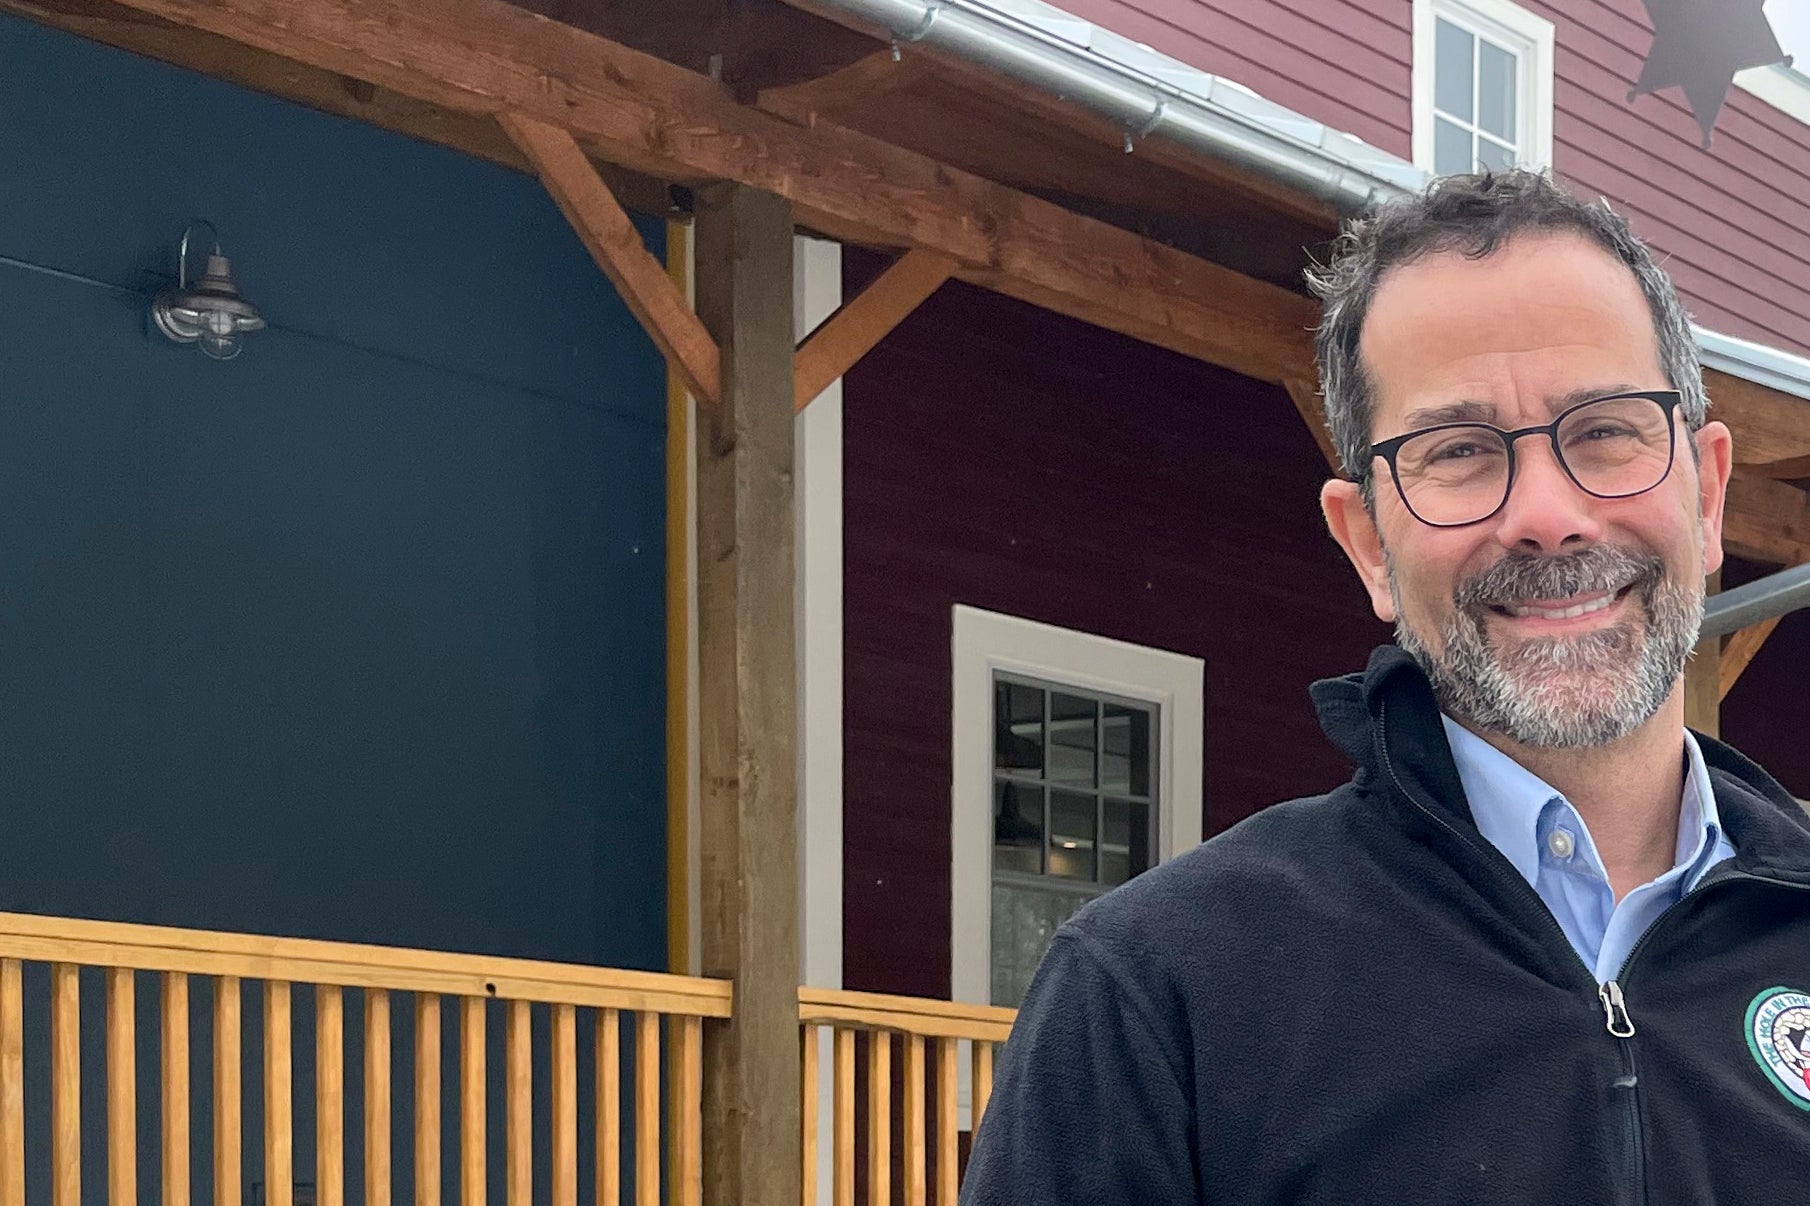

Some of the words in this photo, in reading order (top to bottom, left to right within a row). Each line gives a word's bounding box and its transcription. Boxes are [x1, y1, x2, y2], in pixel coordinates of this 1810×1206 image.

[1771, 998, 1787, 1010] IN
[1784, 996, 1808, 1006] THE
[1760, 1008, 1776, 1038] HOLE
[1762, 1043, 1782, 1067] THE
